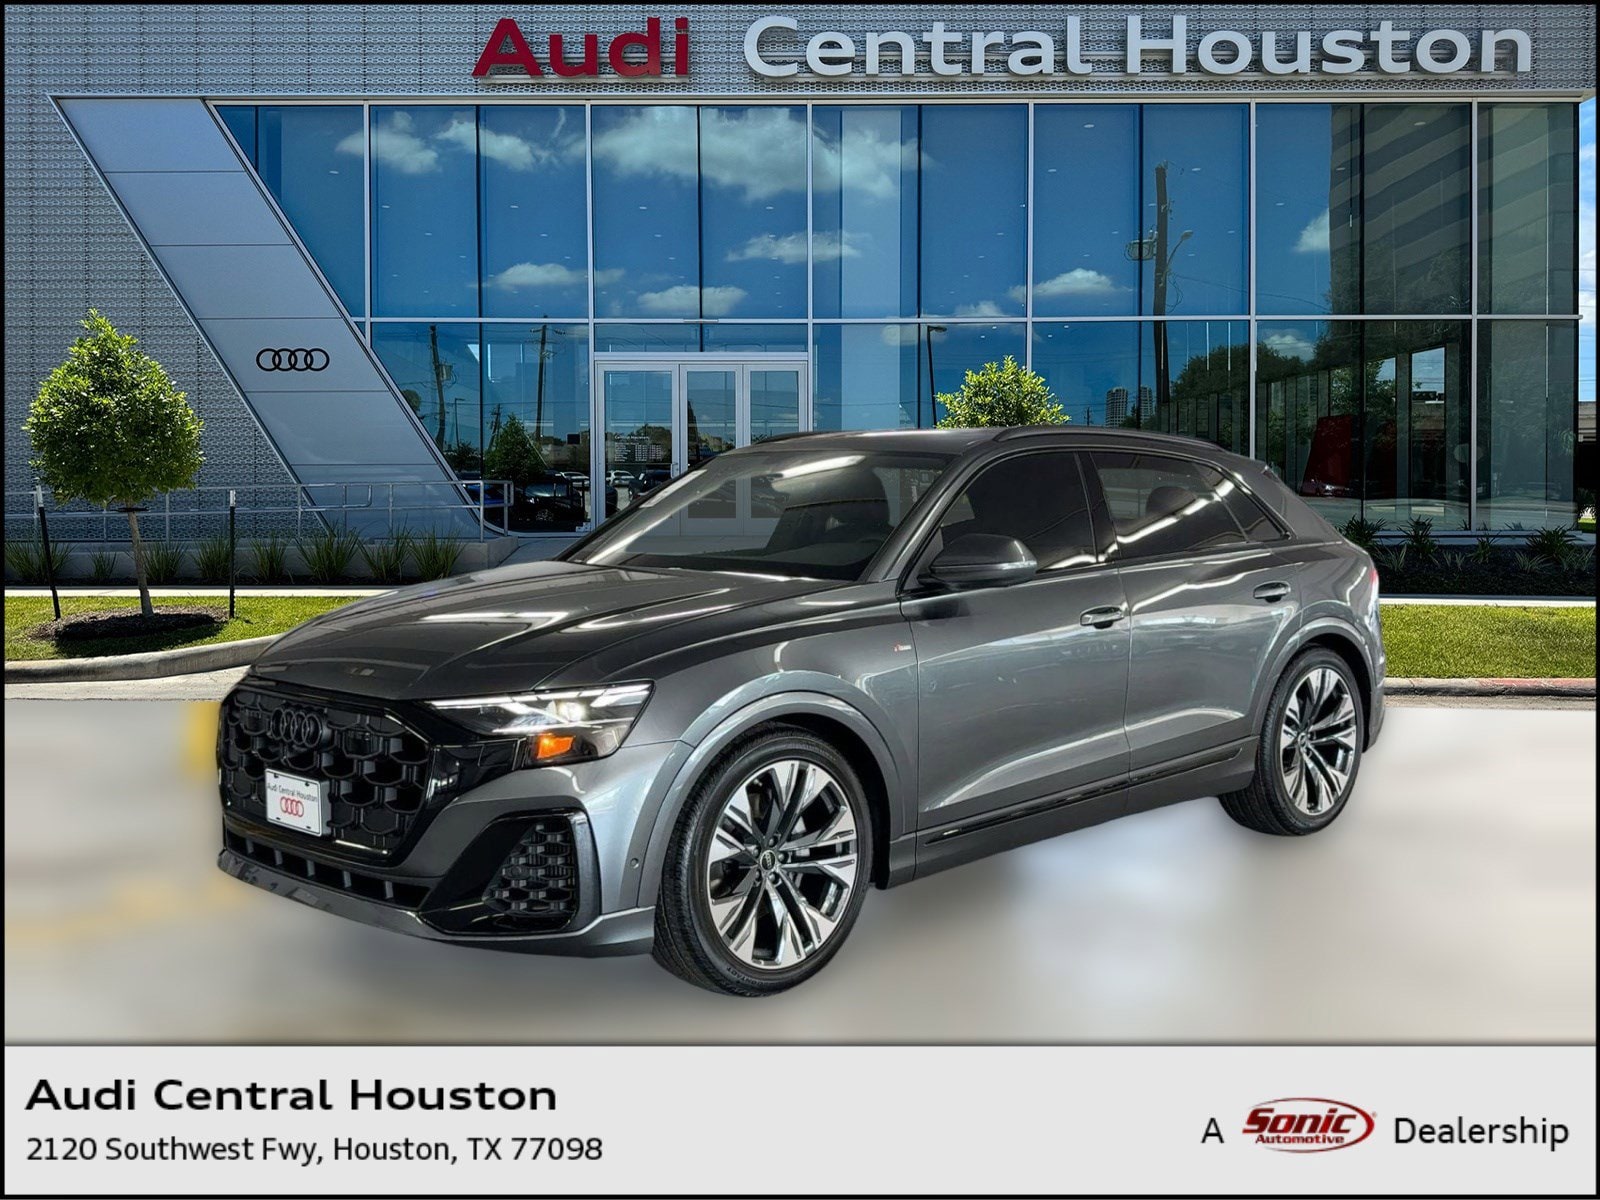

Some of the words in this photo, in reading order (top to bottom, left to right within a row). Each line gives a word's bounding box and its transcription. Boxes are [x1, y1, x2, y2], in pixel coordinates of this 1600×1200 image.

[471, 16, 690, 79] Audi
[743, 15, 1092, 78] Central
[1126, 14, 1532, 76] Houston
[279, 785, 295, 796] Central
[296, 791, 318, 802] Houston
